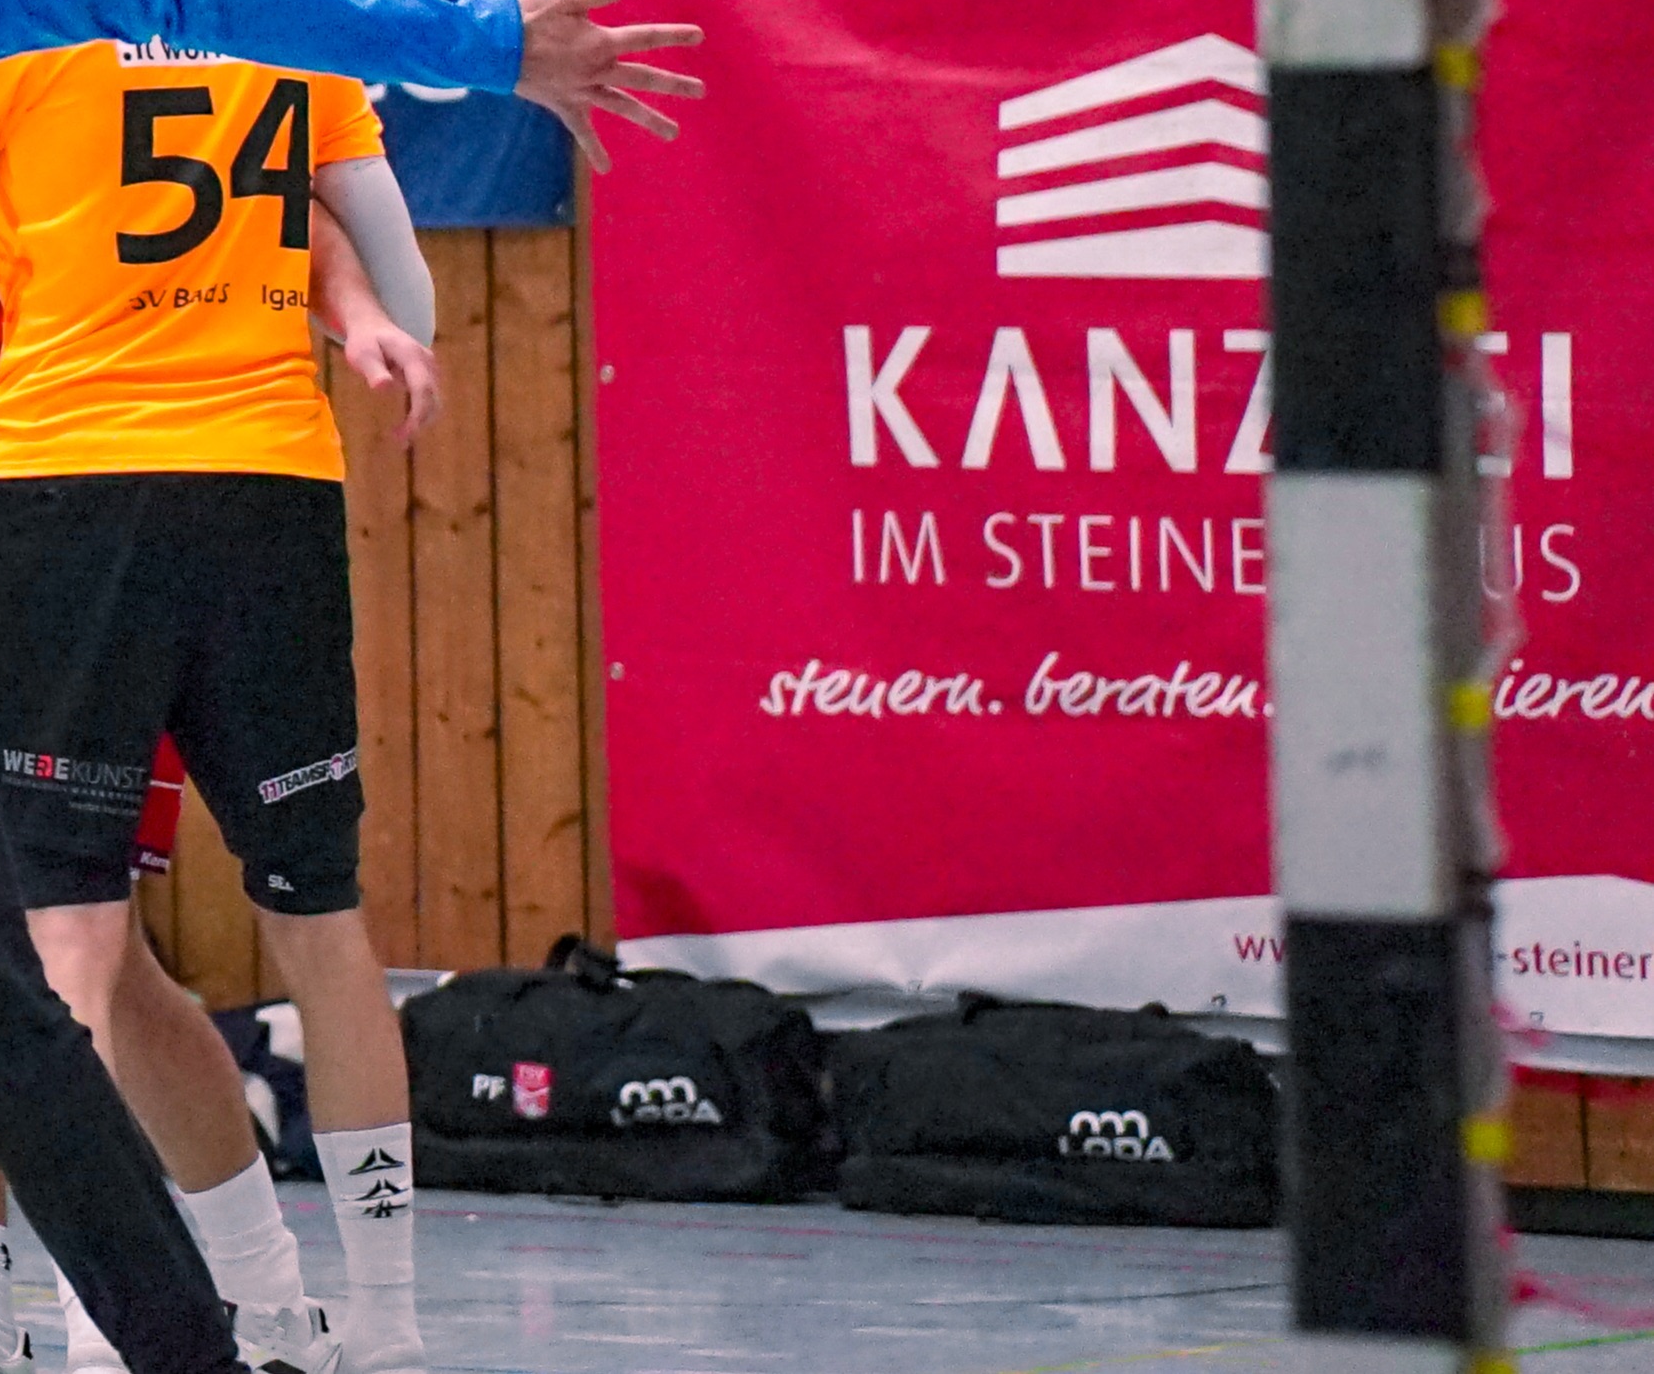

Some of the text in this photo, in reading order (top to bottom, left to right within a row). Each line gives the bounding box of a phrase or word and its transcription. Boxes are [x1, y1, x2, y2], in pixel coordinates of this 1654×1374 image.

[115, 77, 312, 265] 54
[852, 510, 947, 587] IM
[759, 659, 1003, 720] steuern.
[1026, 652, 1275, 720] beraten.
